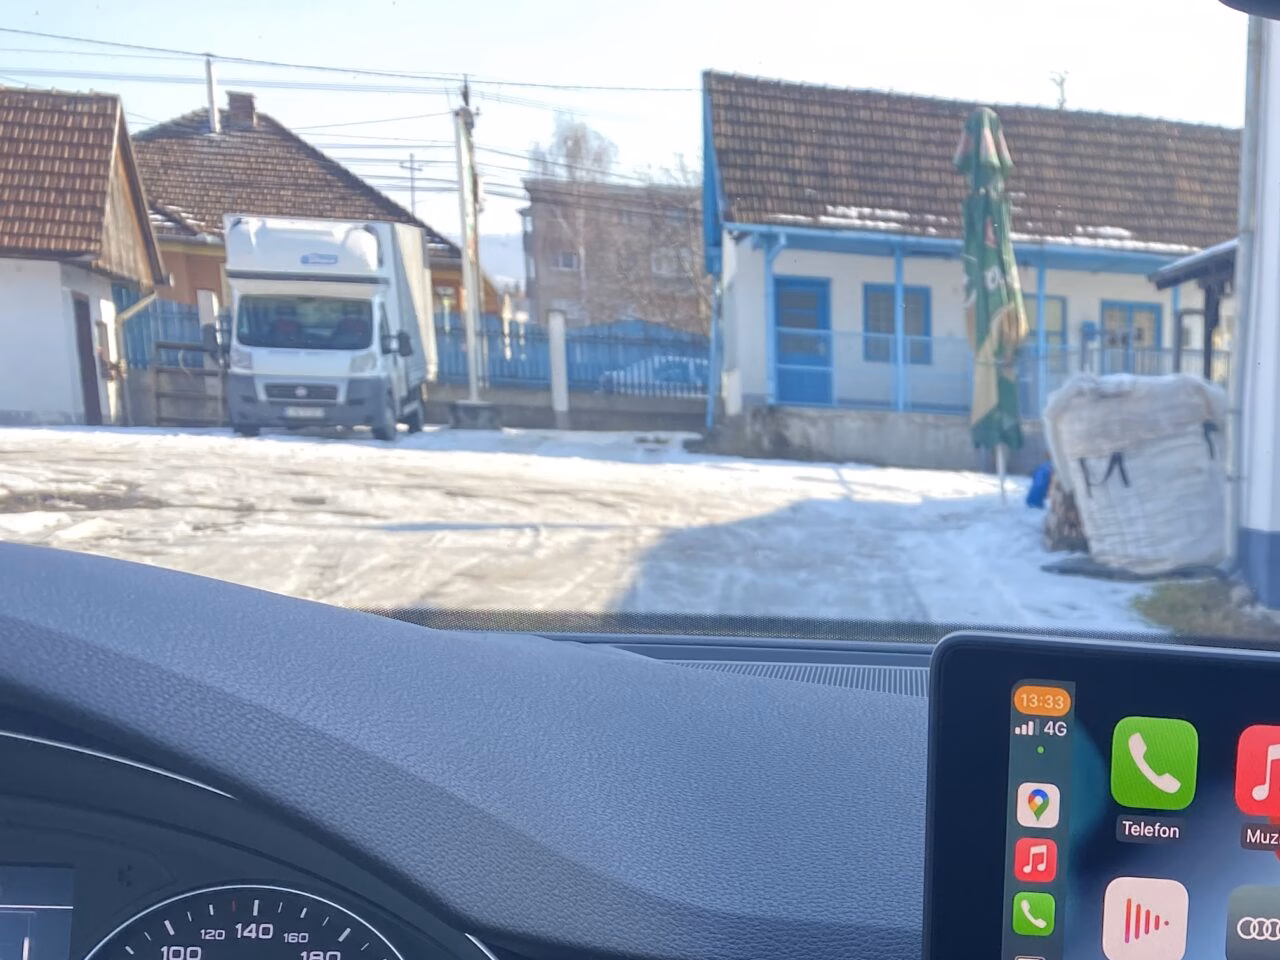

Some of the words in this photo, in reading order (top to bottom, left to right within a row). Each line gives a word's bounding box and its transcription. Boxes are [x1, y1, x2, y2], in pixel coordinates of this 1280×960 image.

[1020, 693, 1065, 710] 13:33
[1043, 721, 1068, 737] 4G
[1122, 820, 1180, 839] Telefon
[200, 929, 226, 940] 120
[235, 923, 274, 939] 140
[283, 932, 309, 943] 160
